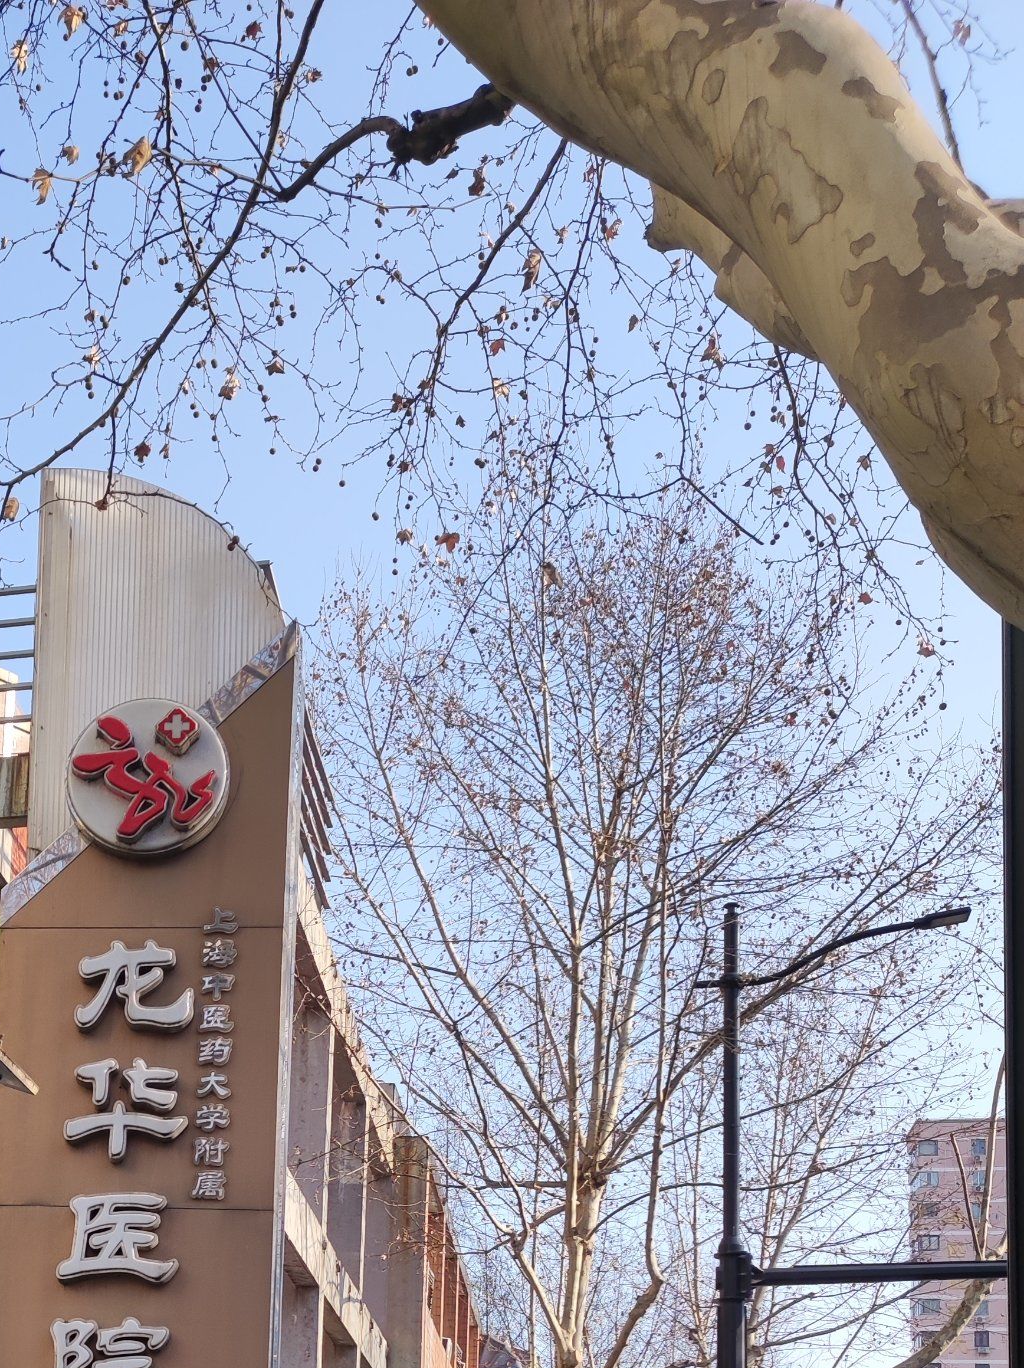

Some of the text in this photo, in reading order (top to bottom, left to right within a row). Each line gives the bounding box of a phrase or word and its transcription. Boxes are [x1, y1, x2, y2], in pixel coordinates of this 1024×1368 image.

[189, 907, 240, 1201] 上海中医药大学附属
